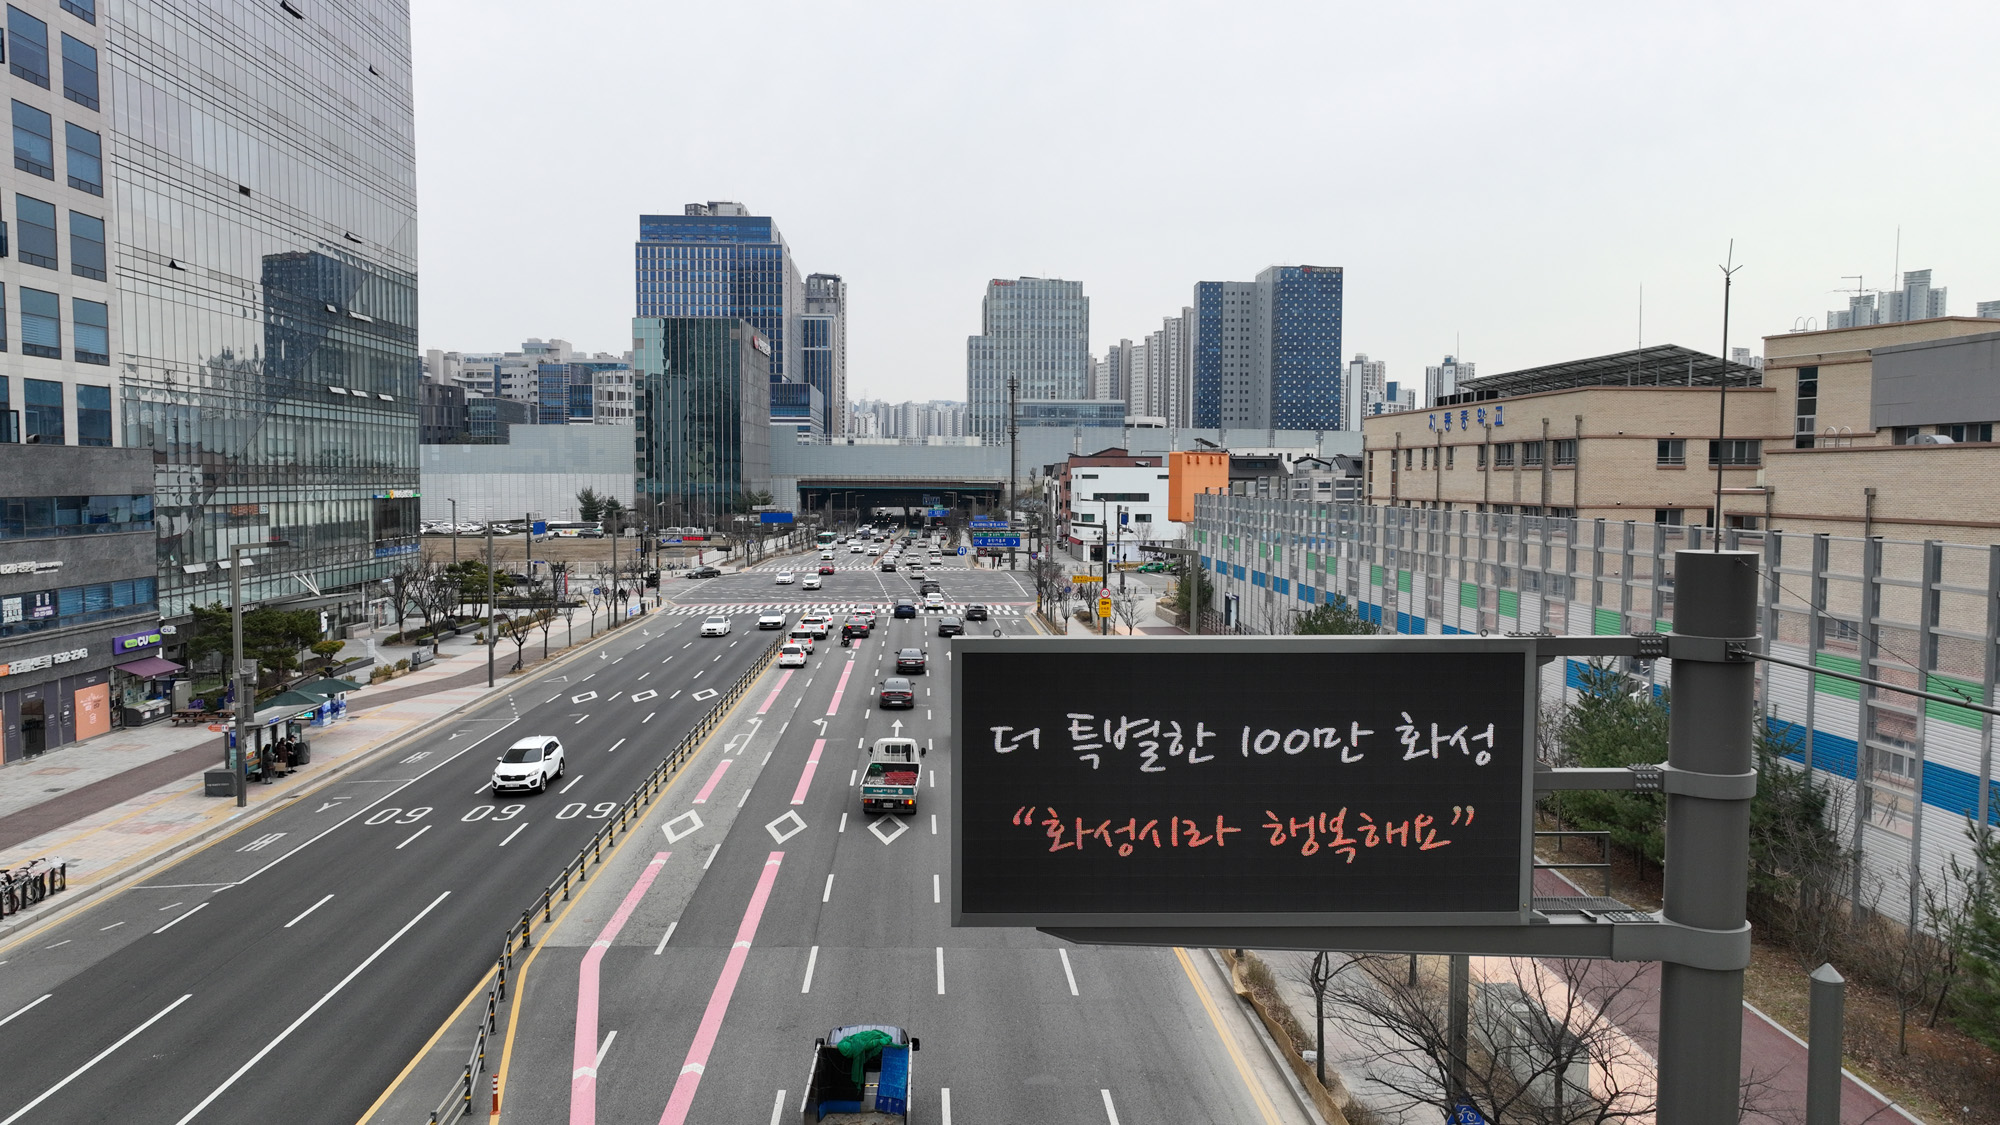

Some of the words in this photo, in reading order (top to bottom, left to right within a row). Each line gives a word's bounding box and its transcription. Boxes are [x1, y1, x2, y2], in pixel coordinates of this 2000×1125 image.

[137, 635, 149, 647] CU
[990, 725, 1040, 754] 더
[1066, 712, 1216, 772] 특별한
[1242, 721, 1374, 763] 100만
[1395, 712, 1495, 766] 화성
[1013, 806, 1241, 857] “화성시라
[1262, 806, 1475, 864] 행복해요”
